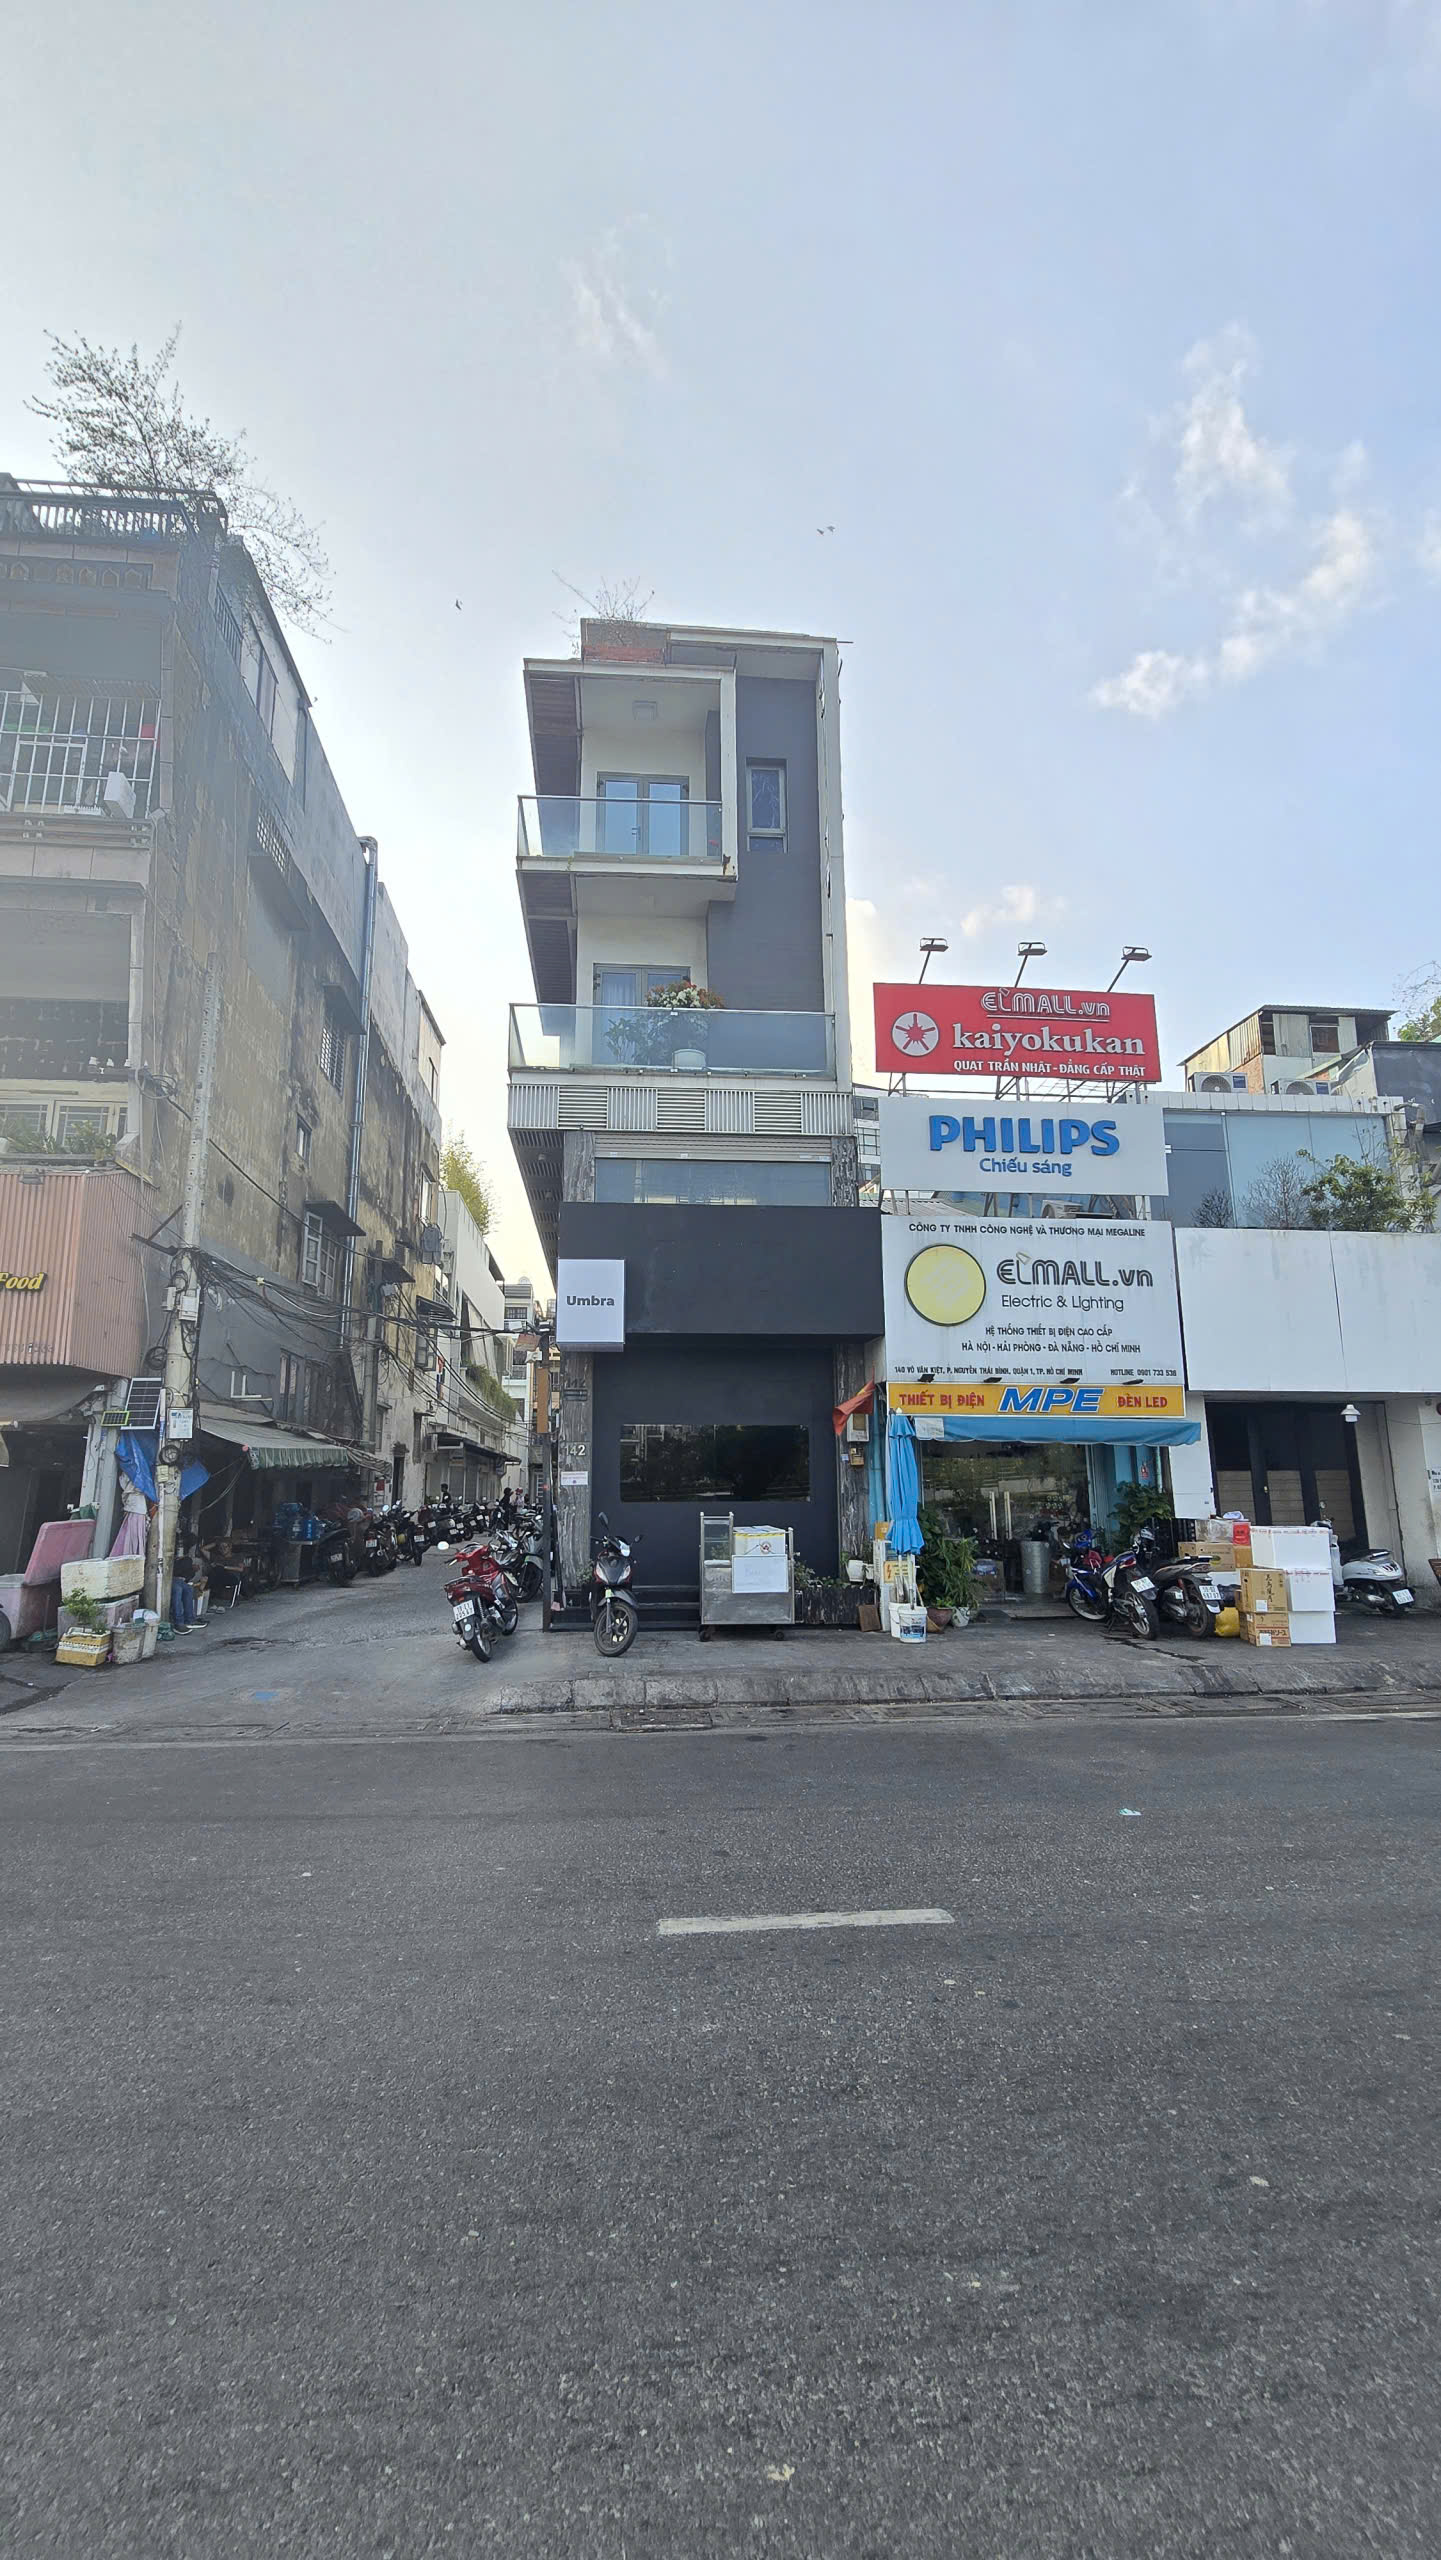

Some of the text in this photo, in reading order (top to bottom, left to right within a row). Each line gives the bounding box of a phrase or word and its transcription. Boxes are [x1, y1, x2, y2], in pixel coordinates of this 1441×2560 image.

[952, 1023, 1146, 1056] kaiyokukan
[953, 1060, 984, 1072] QUẠT
[1022, 1061, 1052, 1075] NHẬT
[1059, 1058, 1090, 1074] ĐẲNG
[1093, 1062, 1115, 1075] CẤP
[1118, 1064, 1146, 1078] THẬT
[929, 1115, 1120, 1156] PHILIPS
[979, 1157, 1072, 1177] Chiếu sáng
[908, 1222, 1146, 1237] CÔNG TY TNHH CÔNG NGHỆ VÀ THƯƠNG MẠI MEGALINE
[566, 1295, 615, 1306] Umbra
[1001, 1295, 1124, 1312] Electric & Lighting
[985, 1325, 995, 1336] HỆ
[997, 1323, 1025, 1335] THỐNG
[1026, 1323, 1046, 1335] THIẾT
[1049, 1328, 1056, 1337] BỊ
[1058, 1326, 1075, 1337] ĐIỆN
[1077, 1328, 1094, 1336] CAO
[961, 1340, 974, 1351] HÀ
[976, 1341, 991, 1353] NỘI
[1013, 1341, 1041, 1352] PHÒNG
[1048, 1341, 1060, 1352] ĐÀ
[1121, 1344, 1141, 1353] MINH
[899, 1389, 984, 1408] THIẾT BỊ ĐIỆN
[998, 1386, 1104, 1412] MPE
[1117, 1393, 1168, 1408] ĐÈN LED
[565, 1444, 586, 1456] 142
